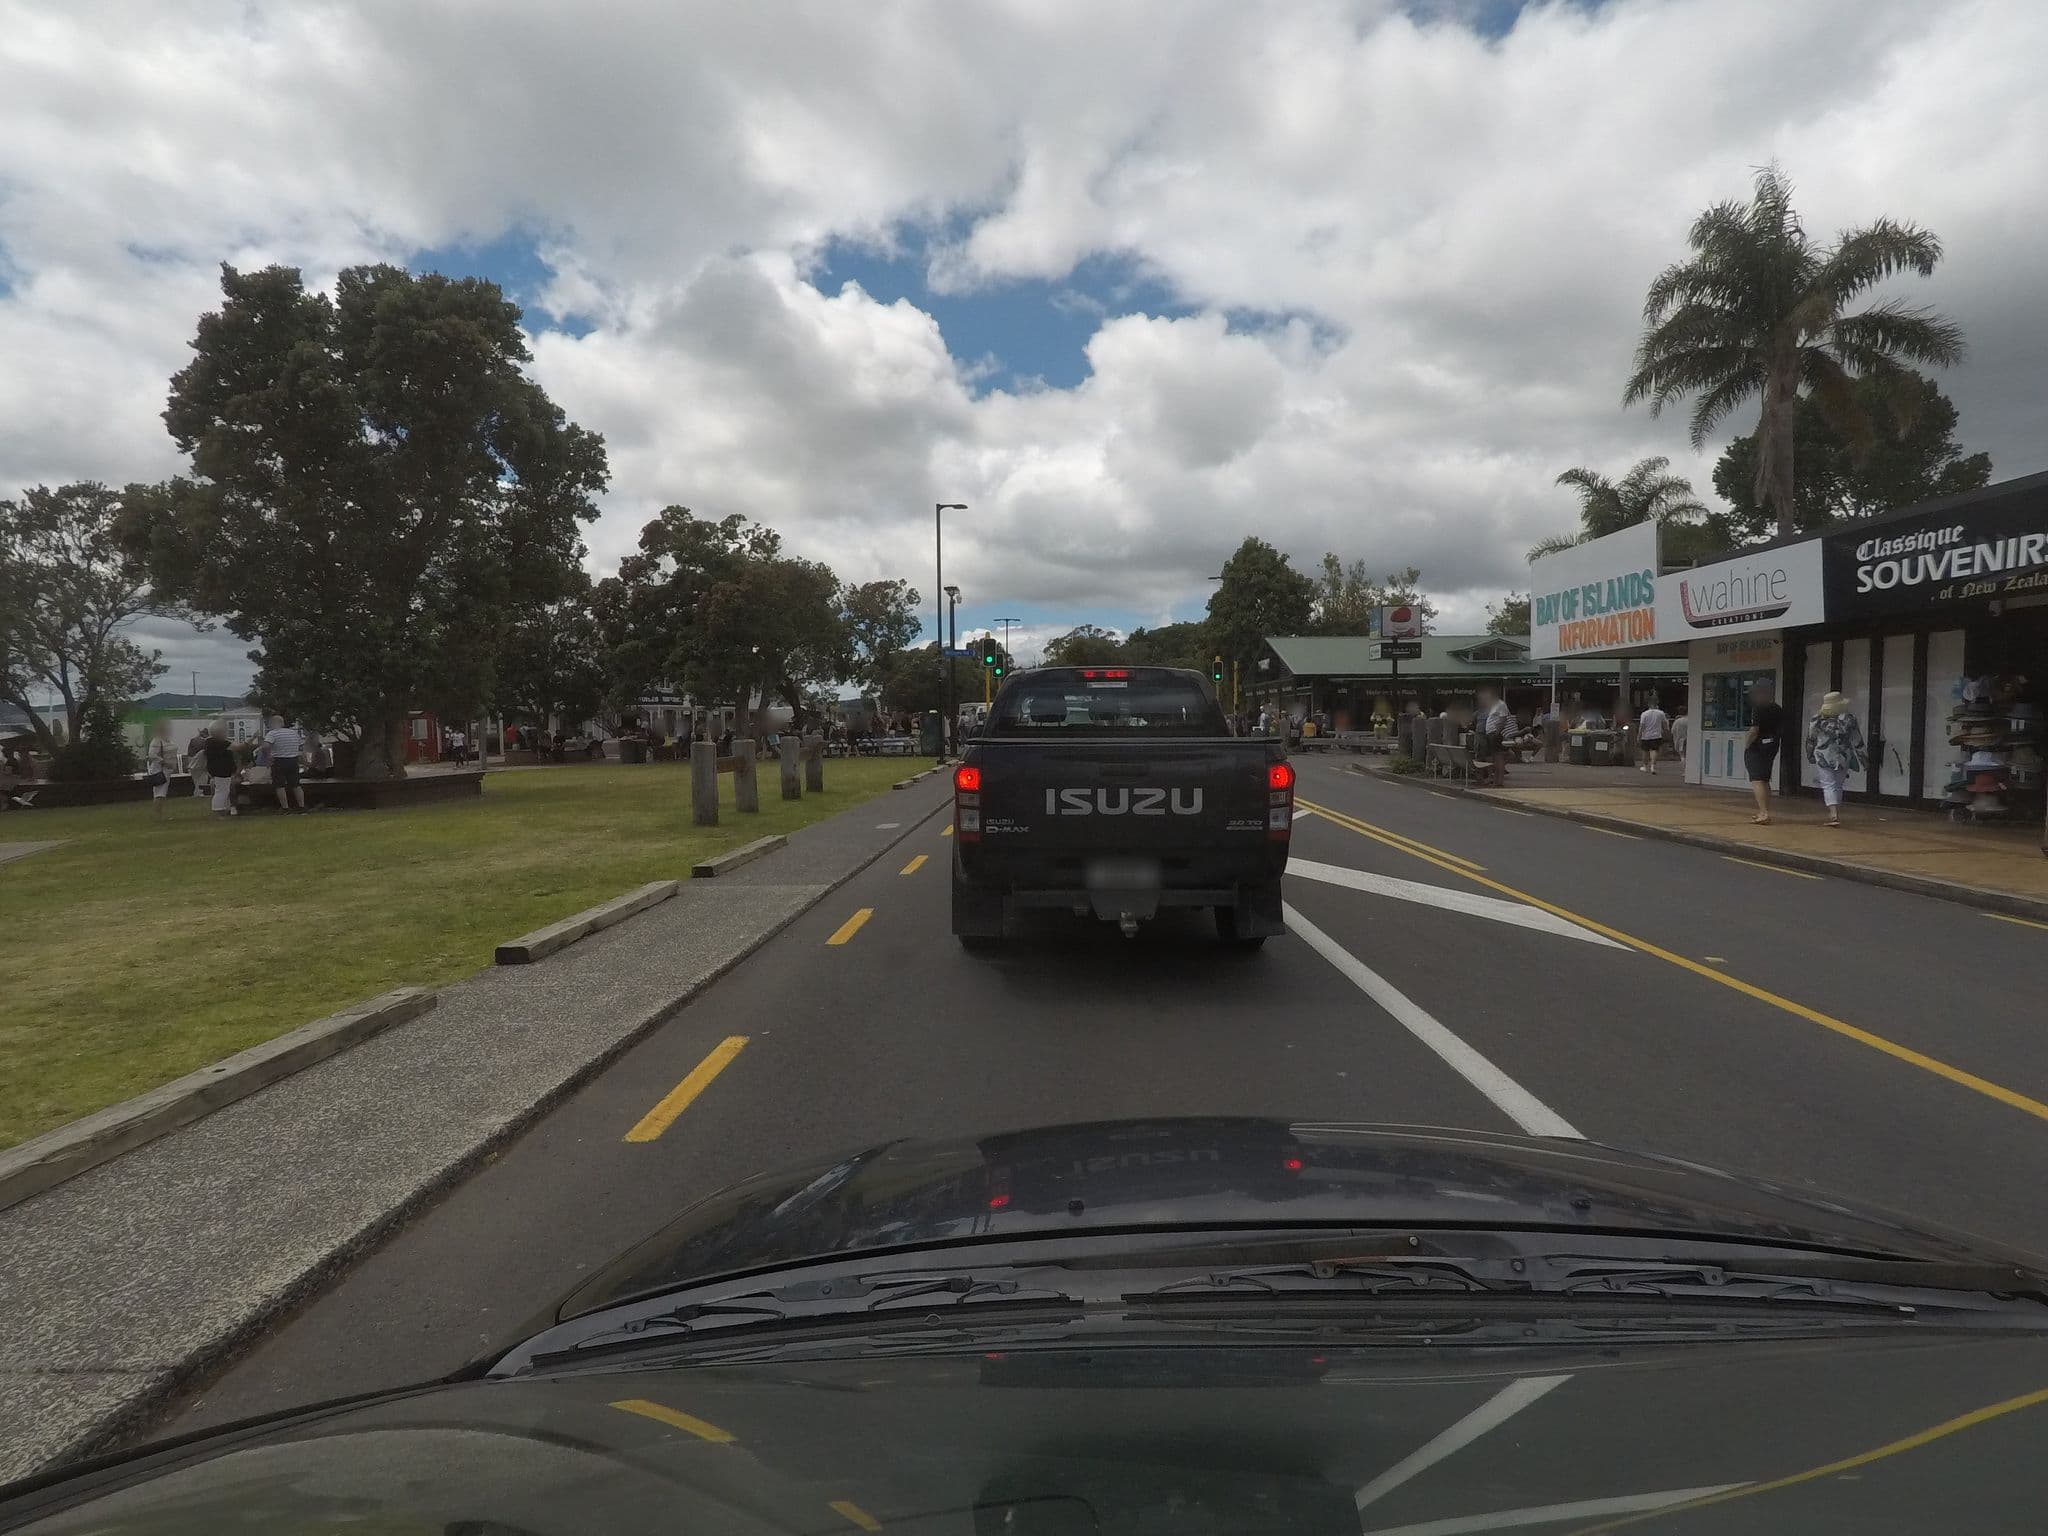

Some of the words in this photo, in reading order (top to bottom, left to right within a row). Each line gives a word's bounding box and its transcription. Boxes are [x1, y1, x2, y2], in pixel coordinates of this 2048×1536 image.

[1856, 525, 1965, 562] Classique
[1857, 532, 2048, 593] SOUVENIR
[1536, 593, 1560, 626] BAY
[1561, 588, 1579, 620] OF
[1581, 569, 1655, 617] ISLANDS
[1692, 567, 1786, 613] wahine
[1939, 585, 1953, 600] of
[1958, 582, 1996, 599] New
[1559, 607, 1655, 652] INFORMATION
[1711, 611, 1765, 626] CREATIONS
[1045, 788, 1203, 816] ISUZU
